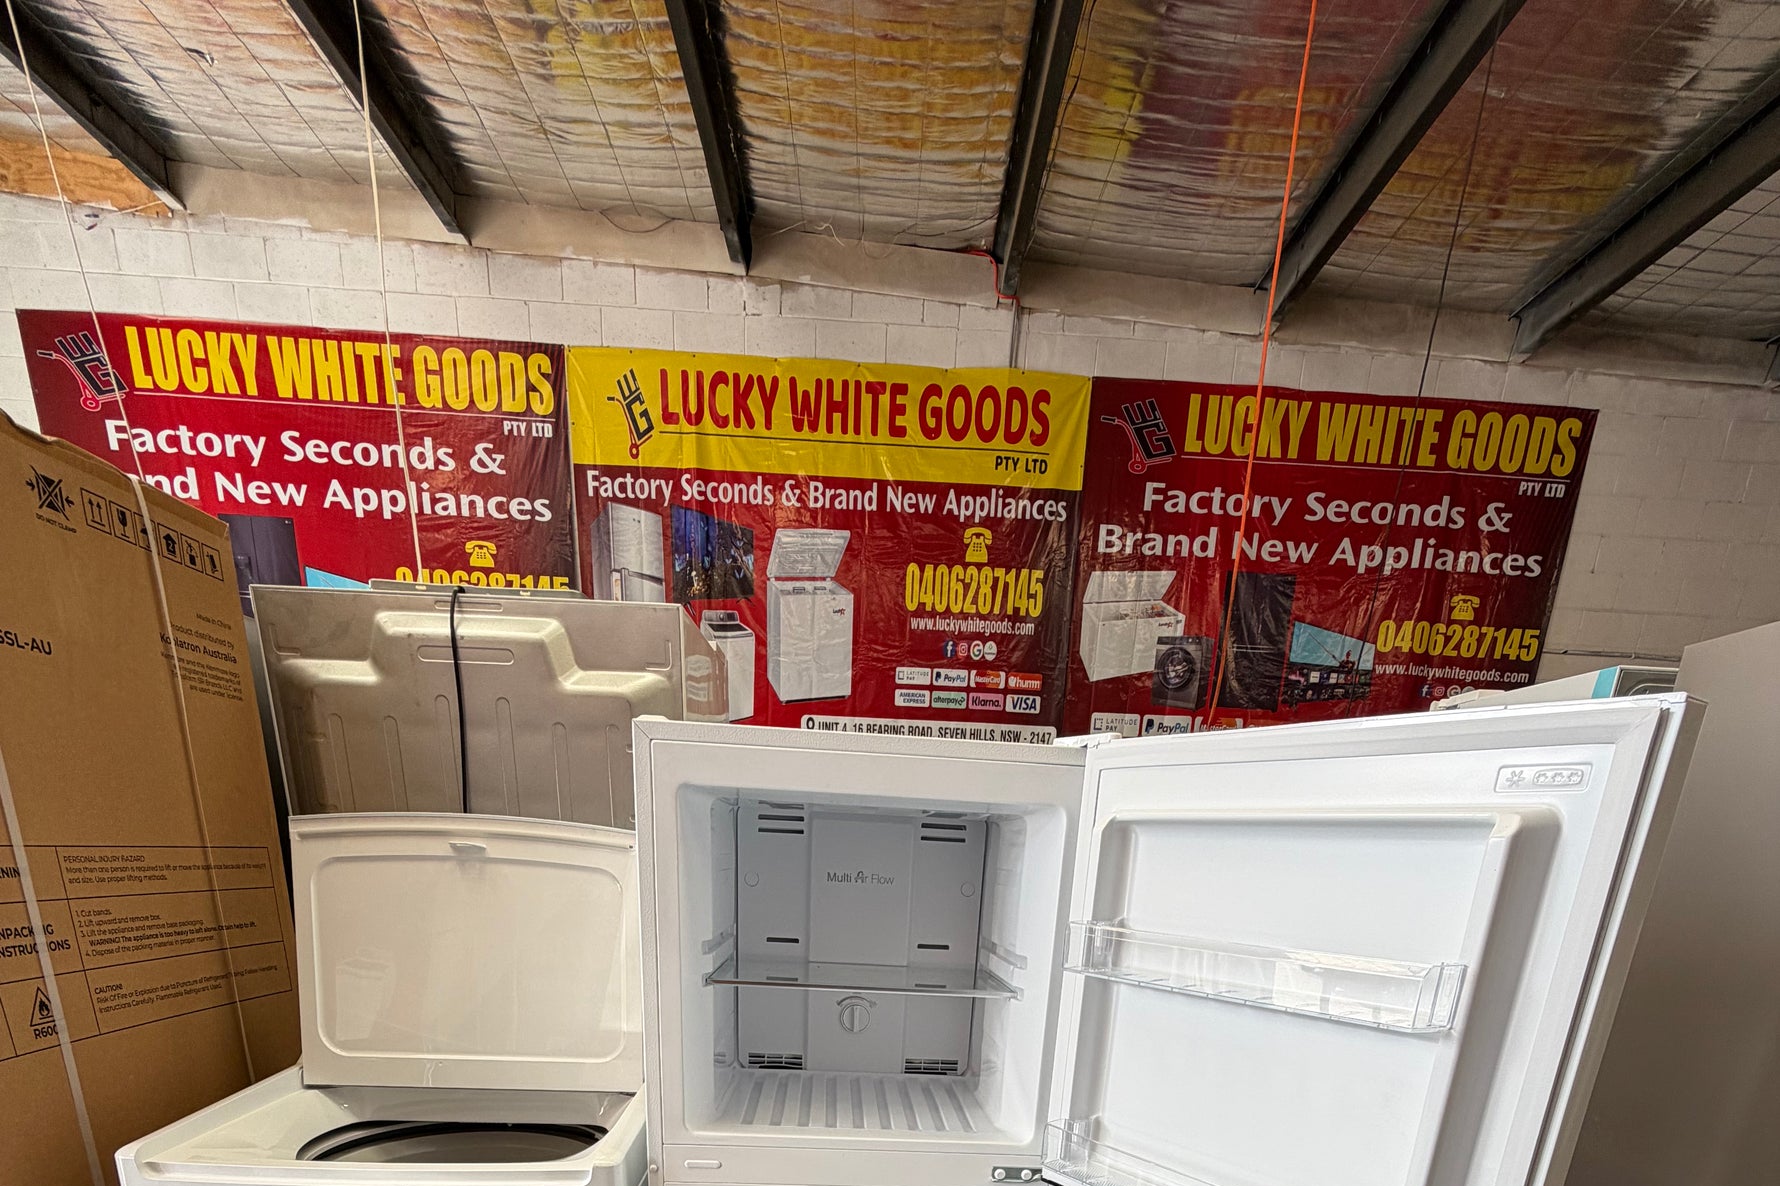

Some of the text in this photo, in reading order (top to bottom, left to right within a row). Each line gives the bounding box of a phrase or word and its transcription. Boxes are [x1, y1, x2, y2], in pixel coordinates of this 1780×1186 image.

[124, 325, 555, 416] LUCKY WHITE GOODS
[659, 367, 1051, 447] LUCKY WHITE GOODS
[503, 420, 553, 438] PTY LTD
[1184, 393, 1583, 477] LUCKY WHITE GOODS
[104, 418, 507, 475] Factory Seconds &
[995, 455, 1048, 474] PTY LTD
[214, 471, 307, 507] New
[323, 478, 552, 522] Appliances
[587, 470, 1067, 523] Factory Seconds & Brand New Appliances
[1518, 481, 1566, 498] PTY LTD
[1143, 481, 1513, 533] Factory Seconds &
[1097, 523, 1543, 578] Brand New Appliances
[905, 562, 1045, 618] 0406287145
[911, 615, 1035, 636] www.luckywhitegoods.com
[159, 632, 238, 664] Kolatron Australia
[1376, 619, 1540, 662] 0406287145
[944, 673, 967, 683] PayPal
[974, 675, 1001, 684] MasterCard
[1375, 662, 1529, 683] www.luckywhitegoods.com
[1016, 676, 1040, 689] humm
[933, 695, 958, 706] afterpay
[1010, 696, 1037, 711] VISA
[1105, 718, 1137, 726] LATITUDE
[1157, 722, 1189, 735] PayPal
[818, 721, 840, 731] UNIT
[937, 727, 967, 740] SEVEN
[1000, 729, 1022, 743] NSW
[1029, 731, 1052, 745] 2147
[63, 855, 99, 864] PERSONAL
[66, 866, 82, 874] More
[110, 866, 130, 874] person
[135, 864, 158, 873] required
[107, 876, 126, 884] proper
[826, 870, 895, 886] Multi Air Flow
[108, 926, 135, 935] appliance
[132, 933, 159, 942] appliance
[131, 943, 153, 952] packing
[117, 993, 128, 1001] Fire
[134, 987, 160, 997] Explosion
[99, 1003, 132, 1013] Instructions
